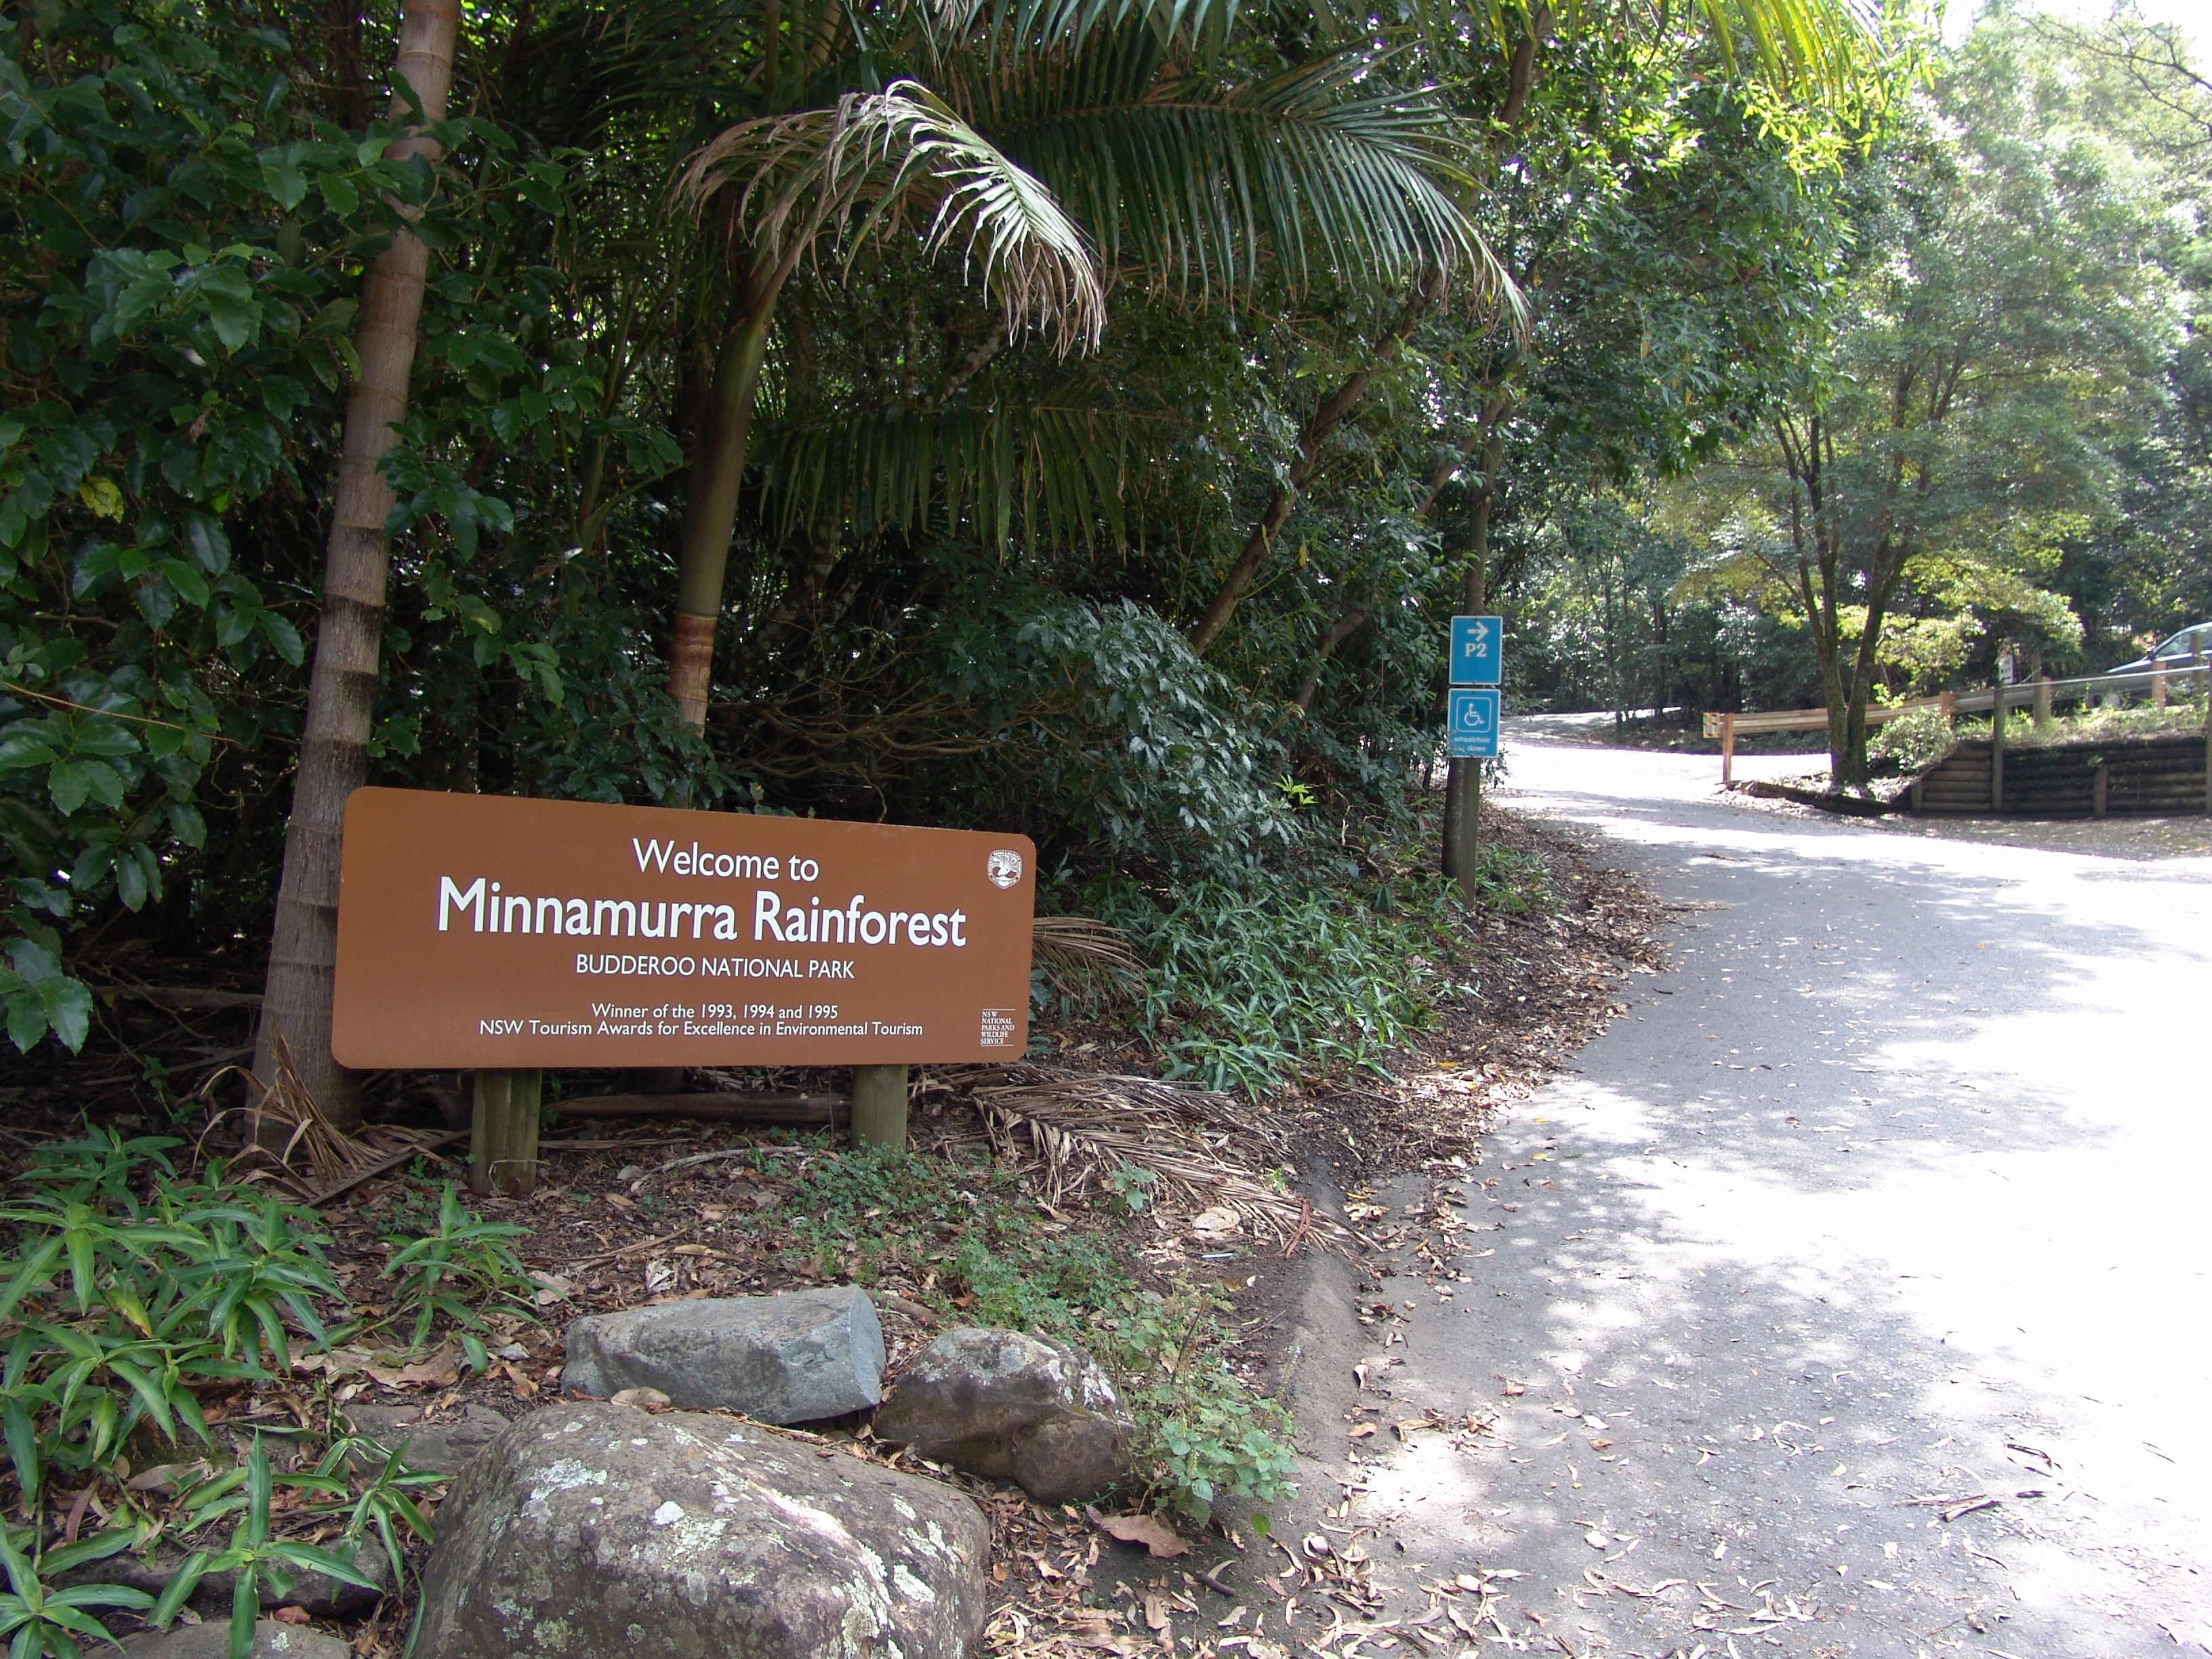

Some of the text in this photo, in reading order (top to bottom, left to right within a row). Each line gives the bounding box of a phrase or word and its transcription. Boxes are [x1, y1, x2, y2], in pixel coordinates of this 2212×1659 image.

[1465, 643, 1487, 657] P2
[632, 838, 819, 882] Welcome to
[436, 876, 968, 947] Minnamurra Rainforest
[576, 953, 855, 979] BUDDEROO NATIONAL PARK
[591, 1002, 838, 1021] Winner of the 1993, 1994 and 1995
[477, 1019, 923, 1036] NSW Tourism Awards for Excellence in Environmental Tourism
